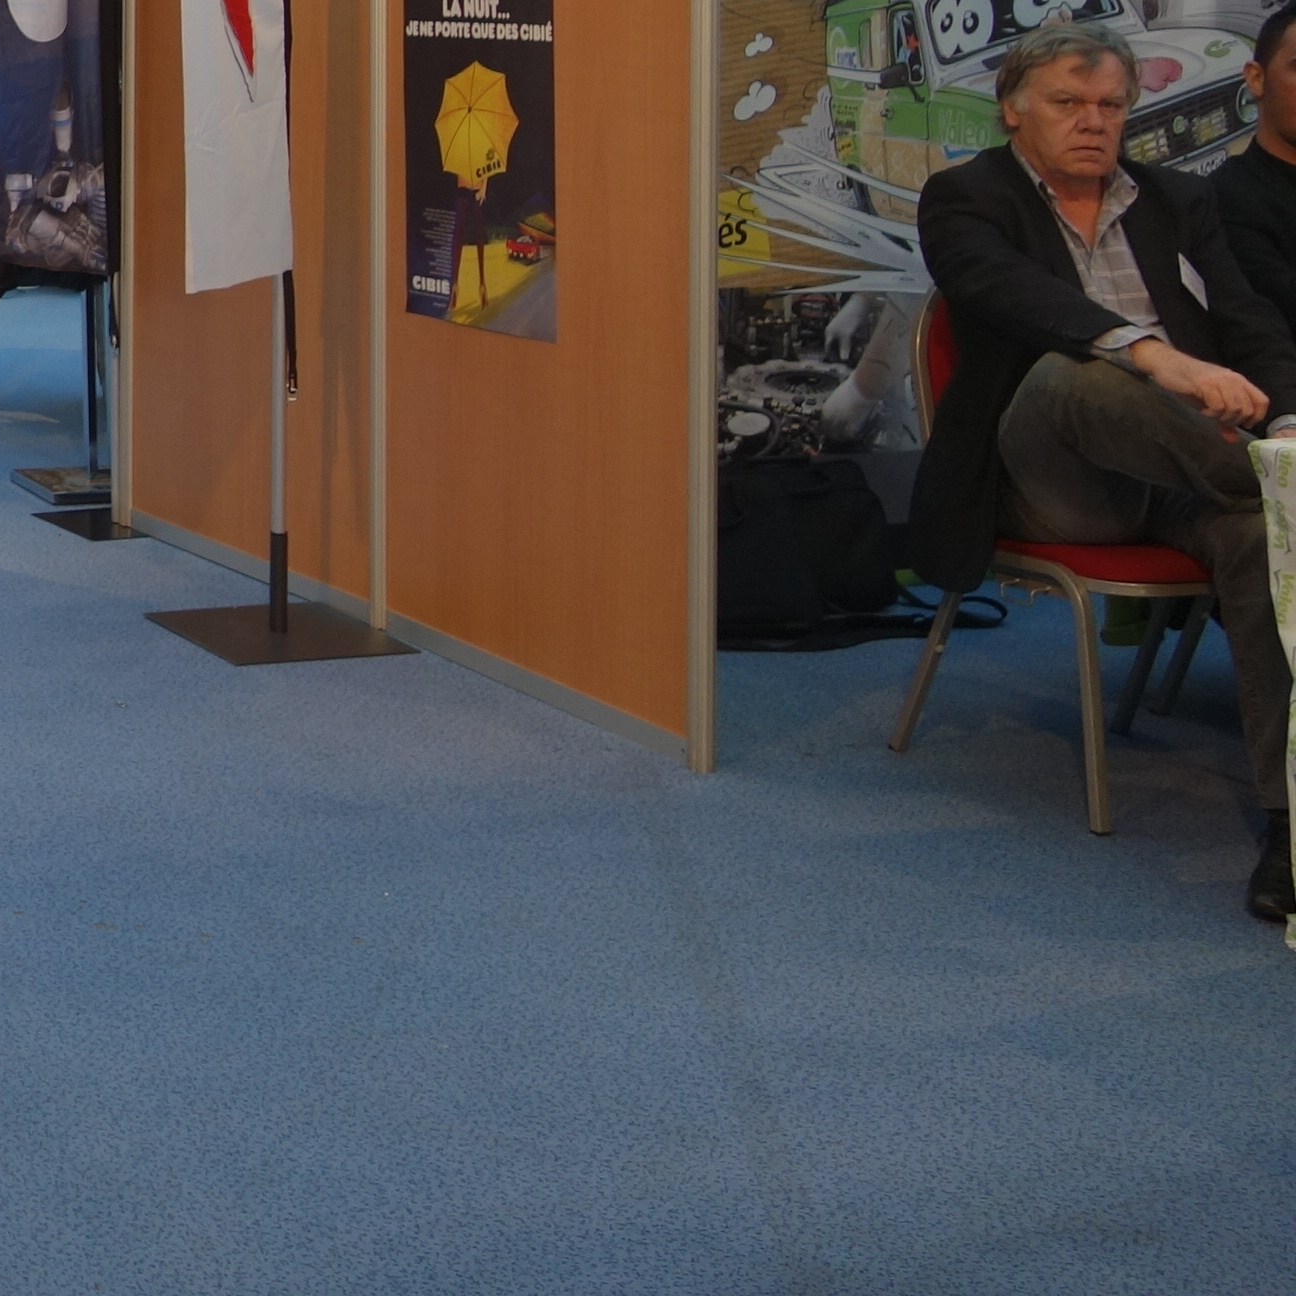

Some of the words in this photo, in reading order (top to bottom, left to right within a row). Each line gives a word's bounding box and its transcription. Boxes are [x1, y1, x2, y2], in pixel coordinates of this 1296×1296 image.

[406, 20, 419, 37] JE
[419, 20, 434, 37] NE
[435, 20, 470, 39] PORTE
[471, 21, 495, 40] QUE
[496, 22, 519, 40] DES
